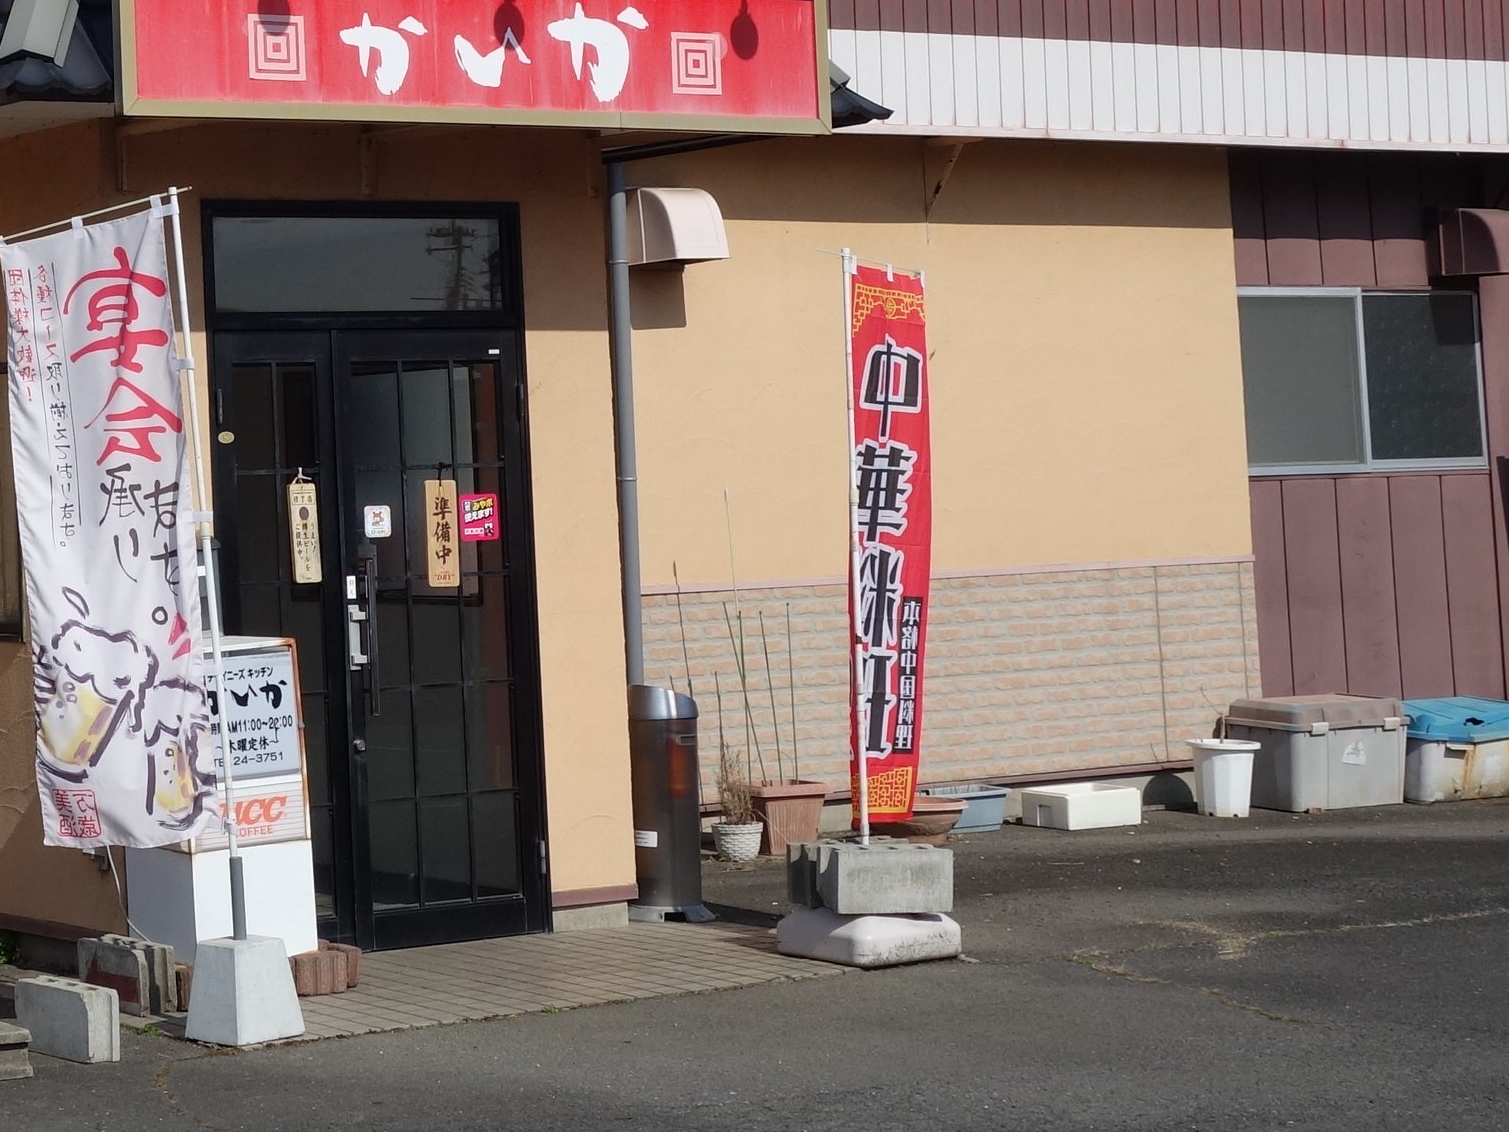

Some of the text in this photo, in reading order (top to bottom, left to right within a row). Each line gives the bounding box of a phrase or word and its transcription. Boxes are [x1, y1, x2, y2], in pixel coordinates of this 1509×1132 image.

[339, 2, 650, 103] かいか
[433, 497, 452, 565] 準備中
[234, 751, 283, 766] 24-3751
[234, 825, 273, 838] OFFEE
